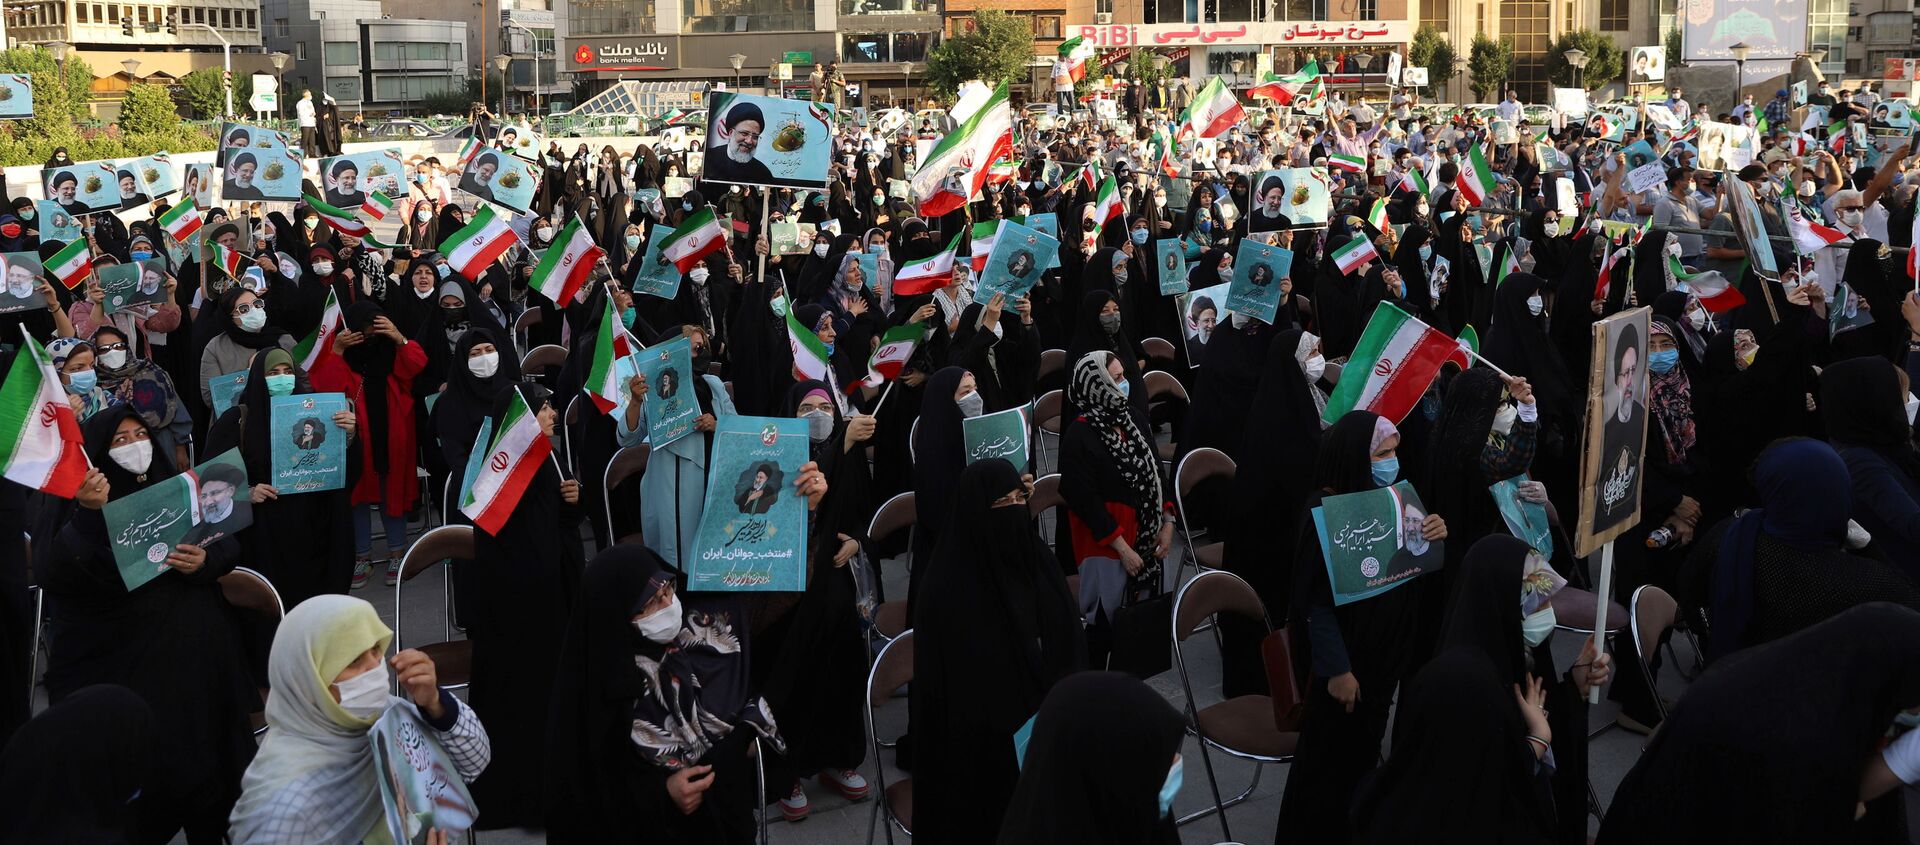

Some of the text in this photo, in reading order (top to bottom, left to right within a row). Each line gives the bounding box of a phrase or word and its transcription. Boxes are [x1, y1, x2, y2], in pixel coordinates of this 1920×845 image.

[599, 42, 632, 56] ملت
[600, 56, 645, 64] bank mellat
[702, 547, 793, 561] #منتخب_جوانان_ایران
